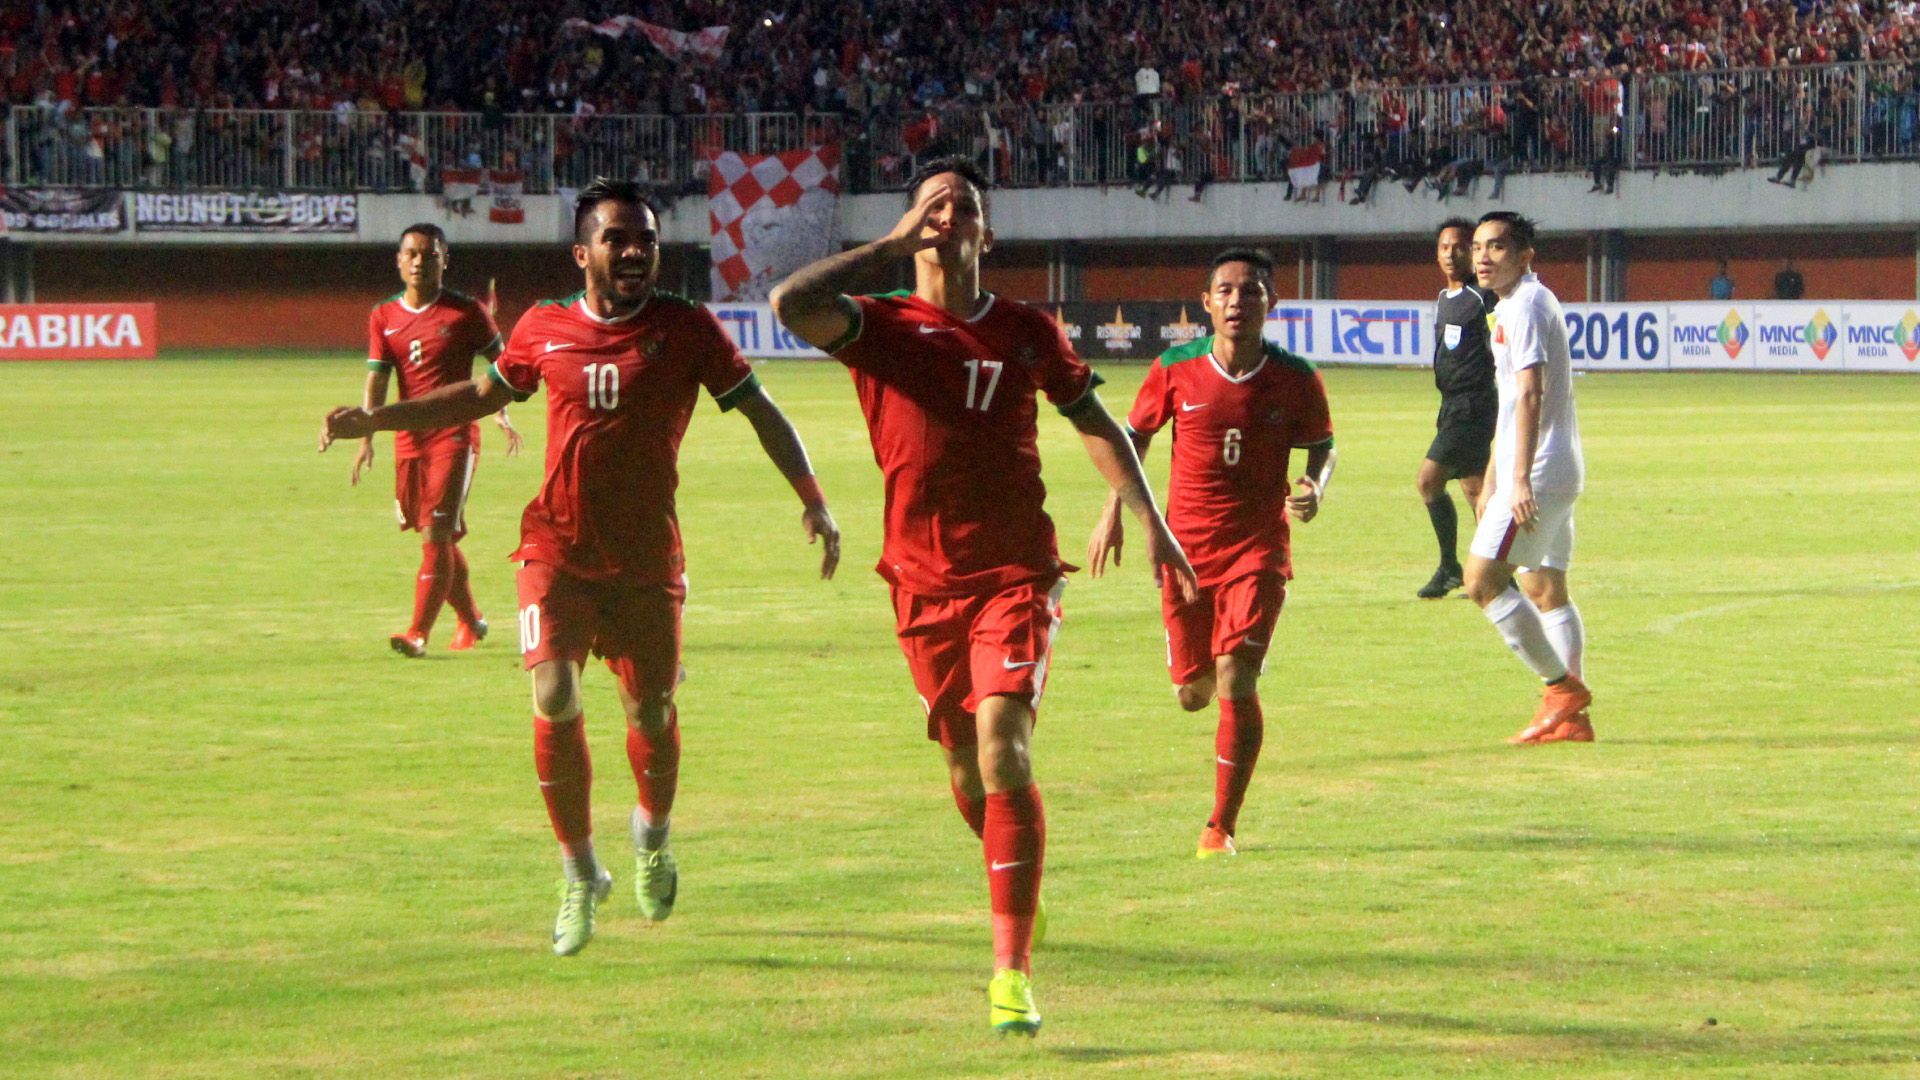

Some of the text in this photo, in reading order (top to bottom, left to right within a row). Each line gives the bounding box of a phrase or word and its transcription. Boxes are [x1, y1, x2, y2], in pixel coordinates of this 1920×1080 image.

[137, 193, 356, 222] NGUNUT BOYS
[716, 310, 760, 349] TI
[1331, 308, 1419, 355] RCTI
[1565, 311, 1660, 361] 2016
[1674, 325, 1717, 343] MNC
[1760, 325, 1805, 343] MNC
[1848, 325, 1895, 344] MNC
[409, 340, 423, 365] 8
[1682, 346, 1711, 356] MEDIA
[1769, 345, 1798, 356] MEDIA
[1857, 346, 1888, 357] MEDIA
[582, 362, 619, 410] 10
[963, 358, 1003, 412] 17
[1223, 427, 1242, 466] 6
[519, 603, 541, 654] 10
